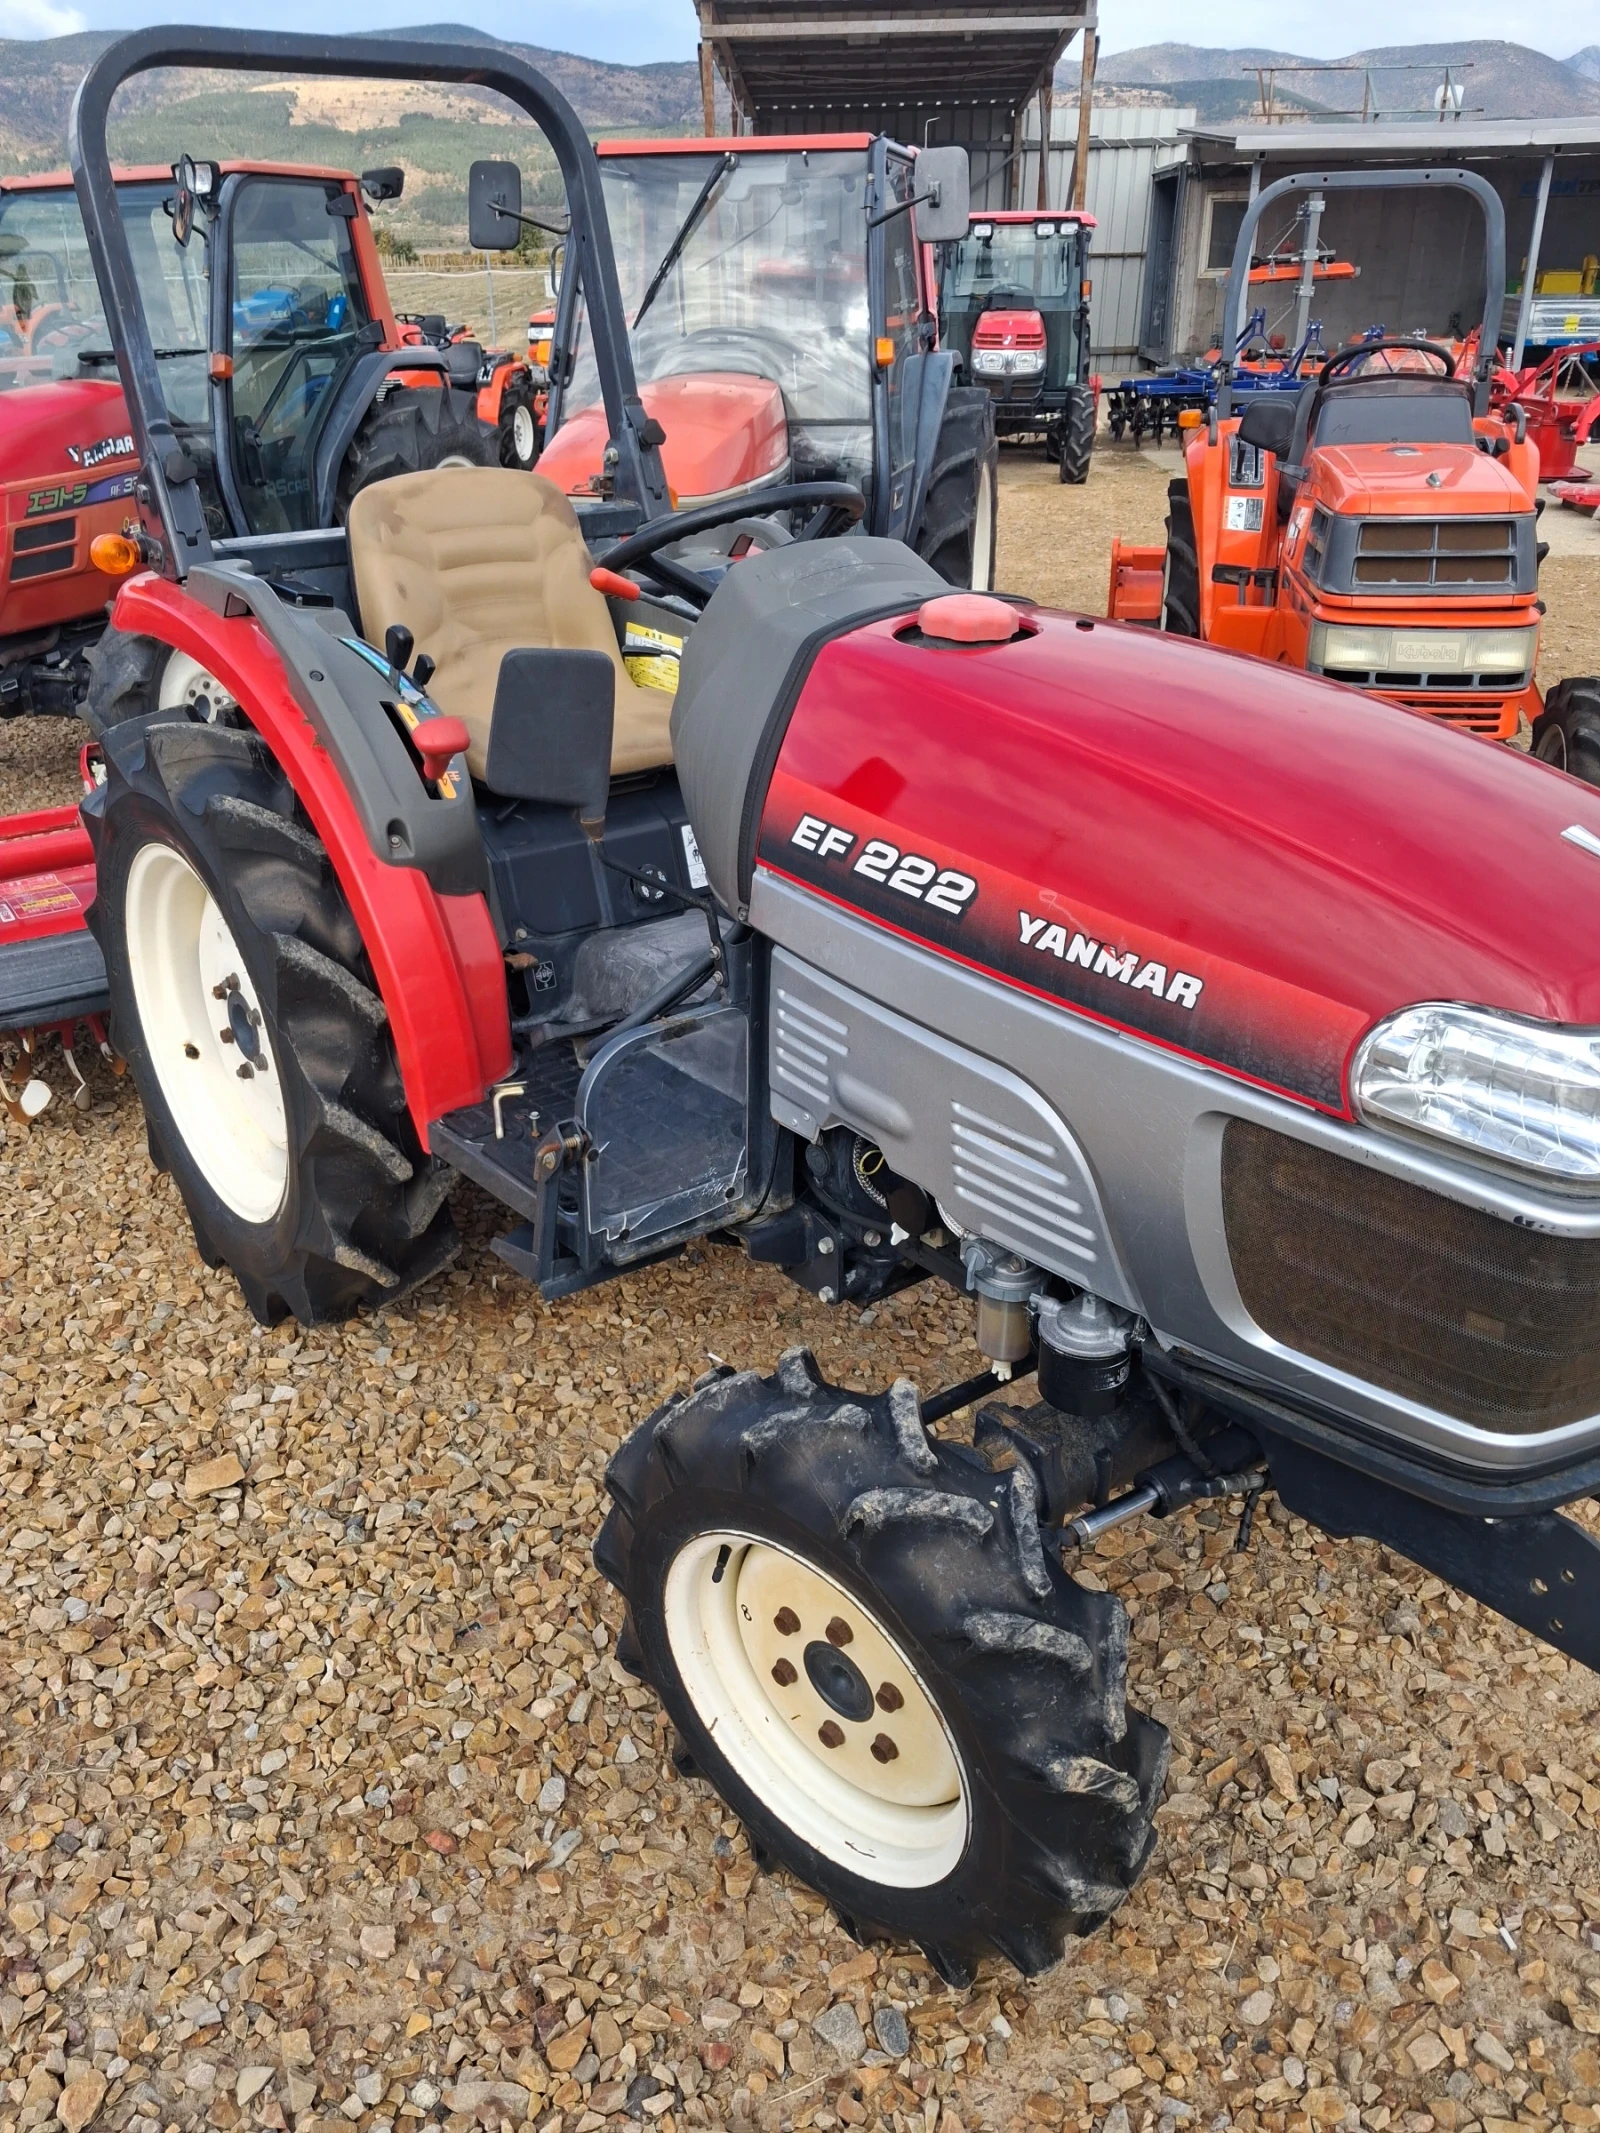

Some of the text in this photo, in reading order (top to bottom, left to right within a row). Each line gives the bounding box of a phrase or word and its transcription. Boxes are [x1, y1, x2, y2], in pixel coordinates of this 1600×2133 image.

[27, 484, 88, 513] エコトラ
[1398, 644, 1457, 661] Kubota
[791, 815, 977, 915] EF 222
[1019, 911, 1203, 1009] YANMAR
